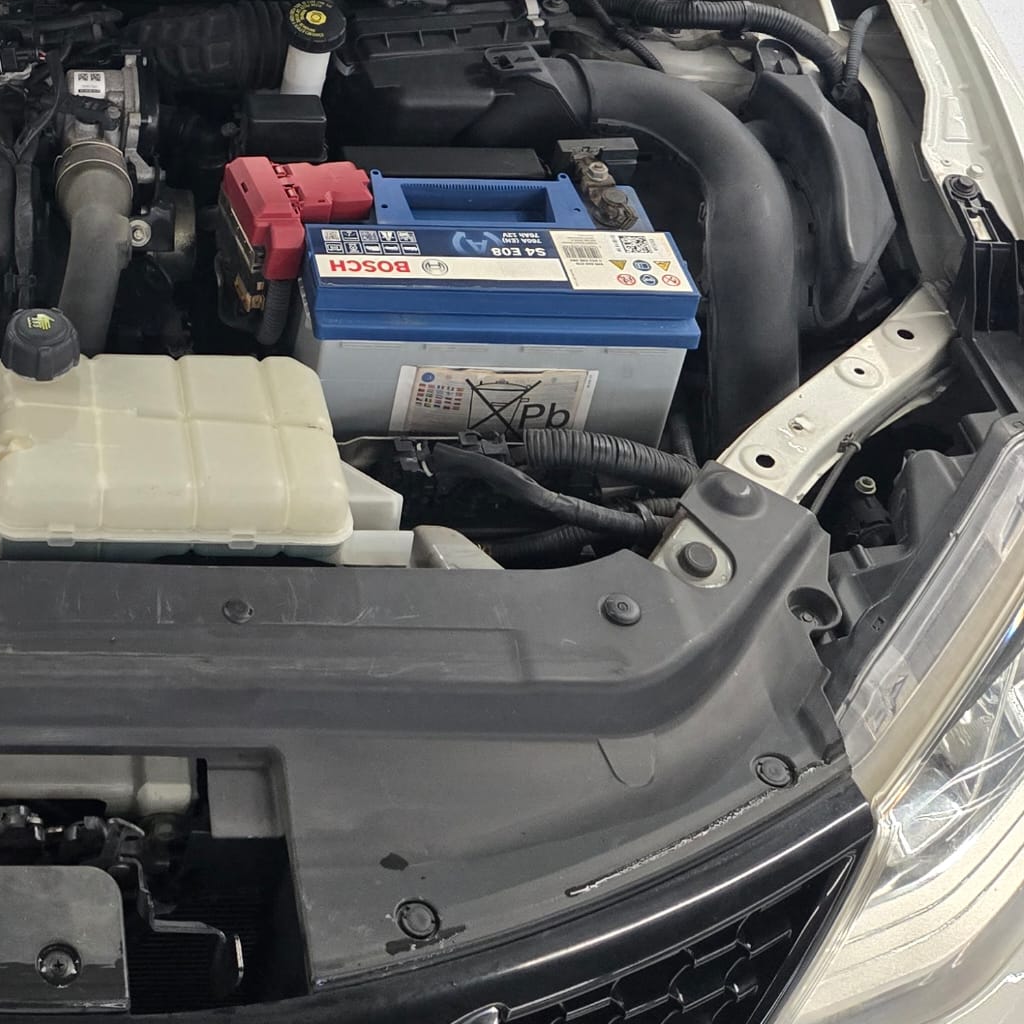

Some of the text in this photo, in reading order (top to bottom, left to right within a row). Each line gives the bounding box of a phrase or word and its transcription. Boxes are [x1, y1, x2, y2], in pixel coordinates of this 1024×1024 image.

[491, 247, 547, 257] S4 E08
[329, 260, 411, 273] BOSCH
[518, 402, 571, 430] Pb
